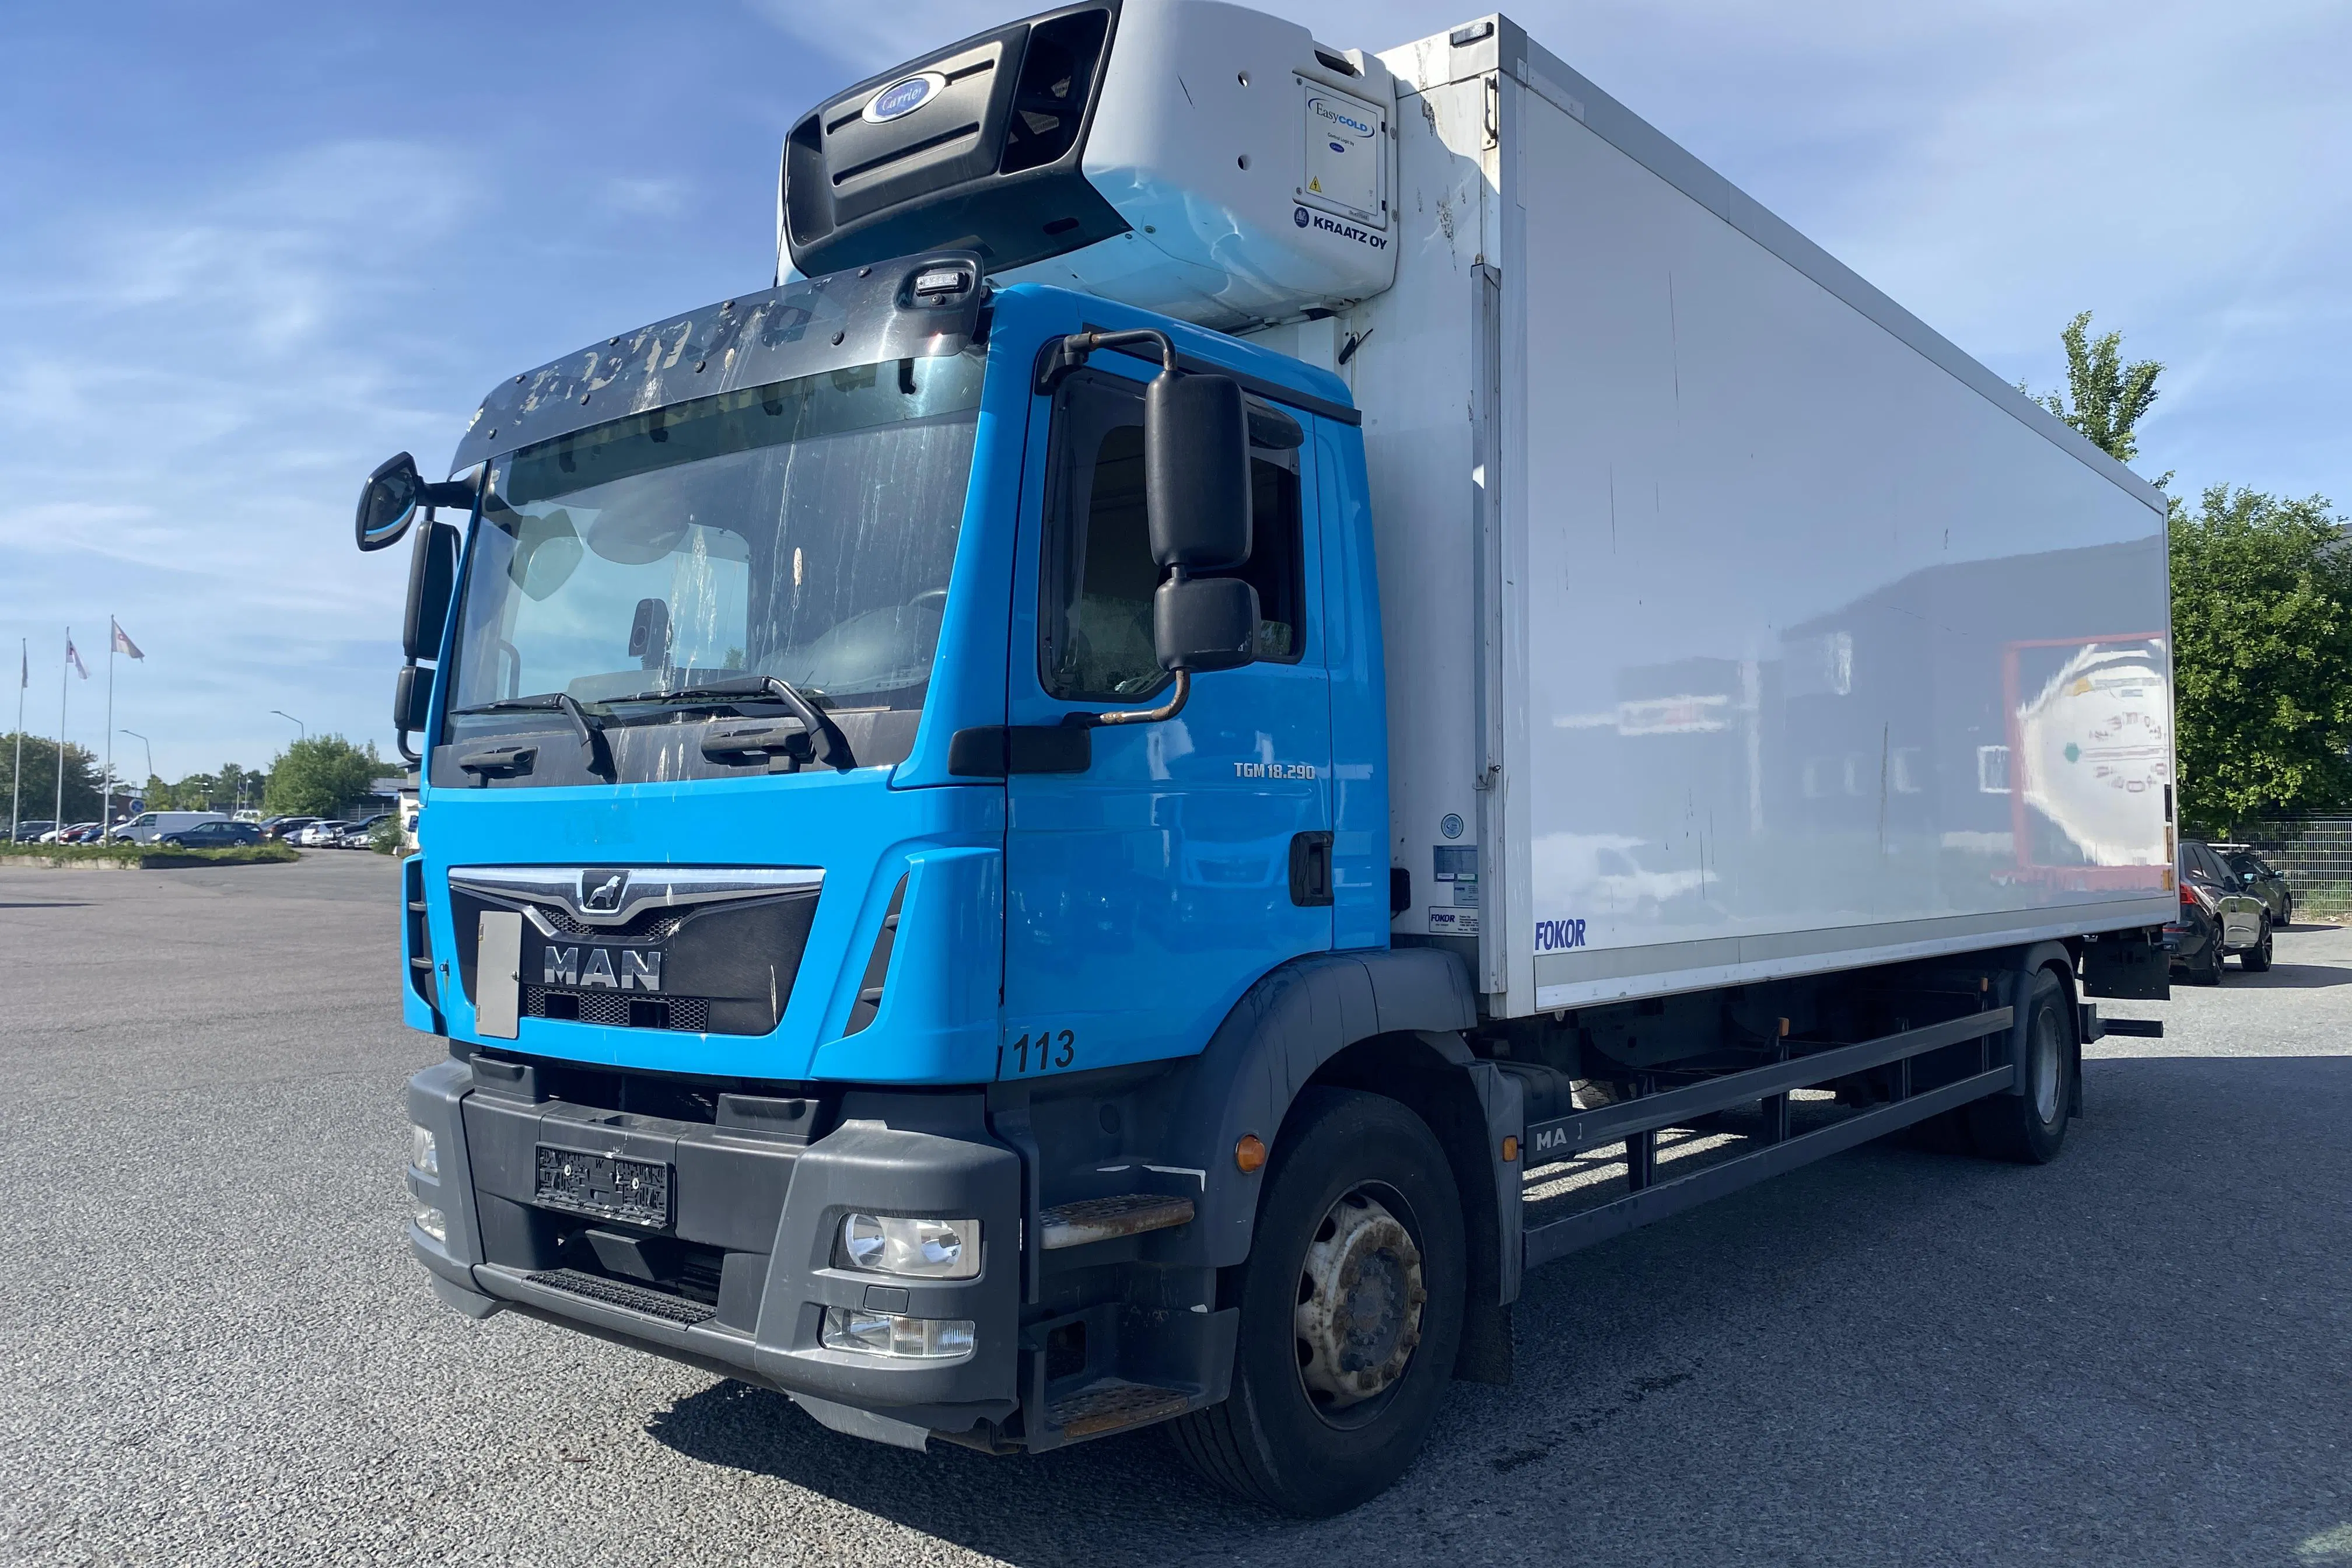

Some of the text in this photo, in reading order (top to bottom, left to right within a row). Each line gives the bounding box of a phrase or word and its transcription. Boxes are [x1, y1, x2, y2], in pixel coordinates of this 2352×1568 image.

[882, 87, 923, 111] Carrier
[1316, 102, 1368, 132] EasyCOLD
[1314, 216, 1367, 243] KRAATZ
[1370, 235, 1387, 250] OY
[1234, 762, 1315, 779] TGM 18.290
[1431, 914, 1455, 922] FOKOR
[1535, 919, 1586, 950] FOKOR
[544, 946, 662, 991] MAN
[1013, 1029, 1074, 1073] 113
